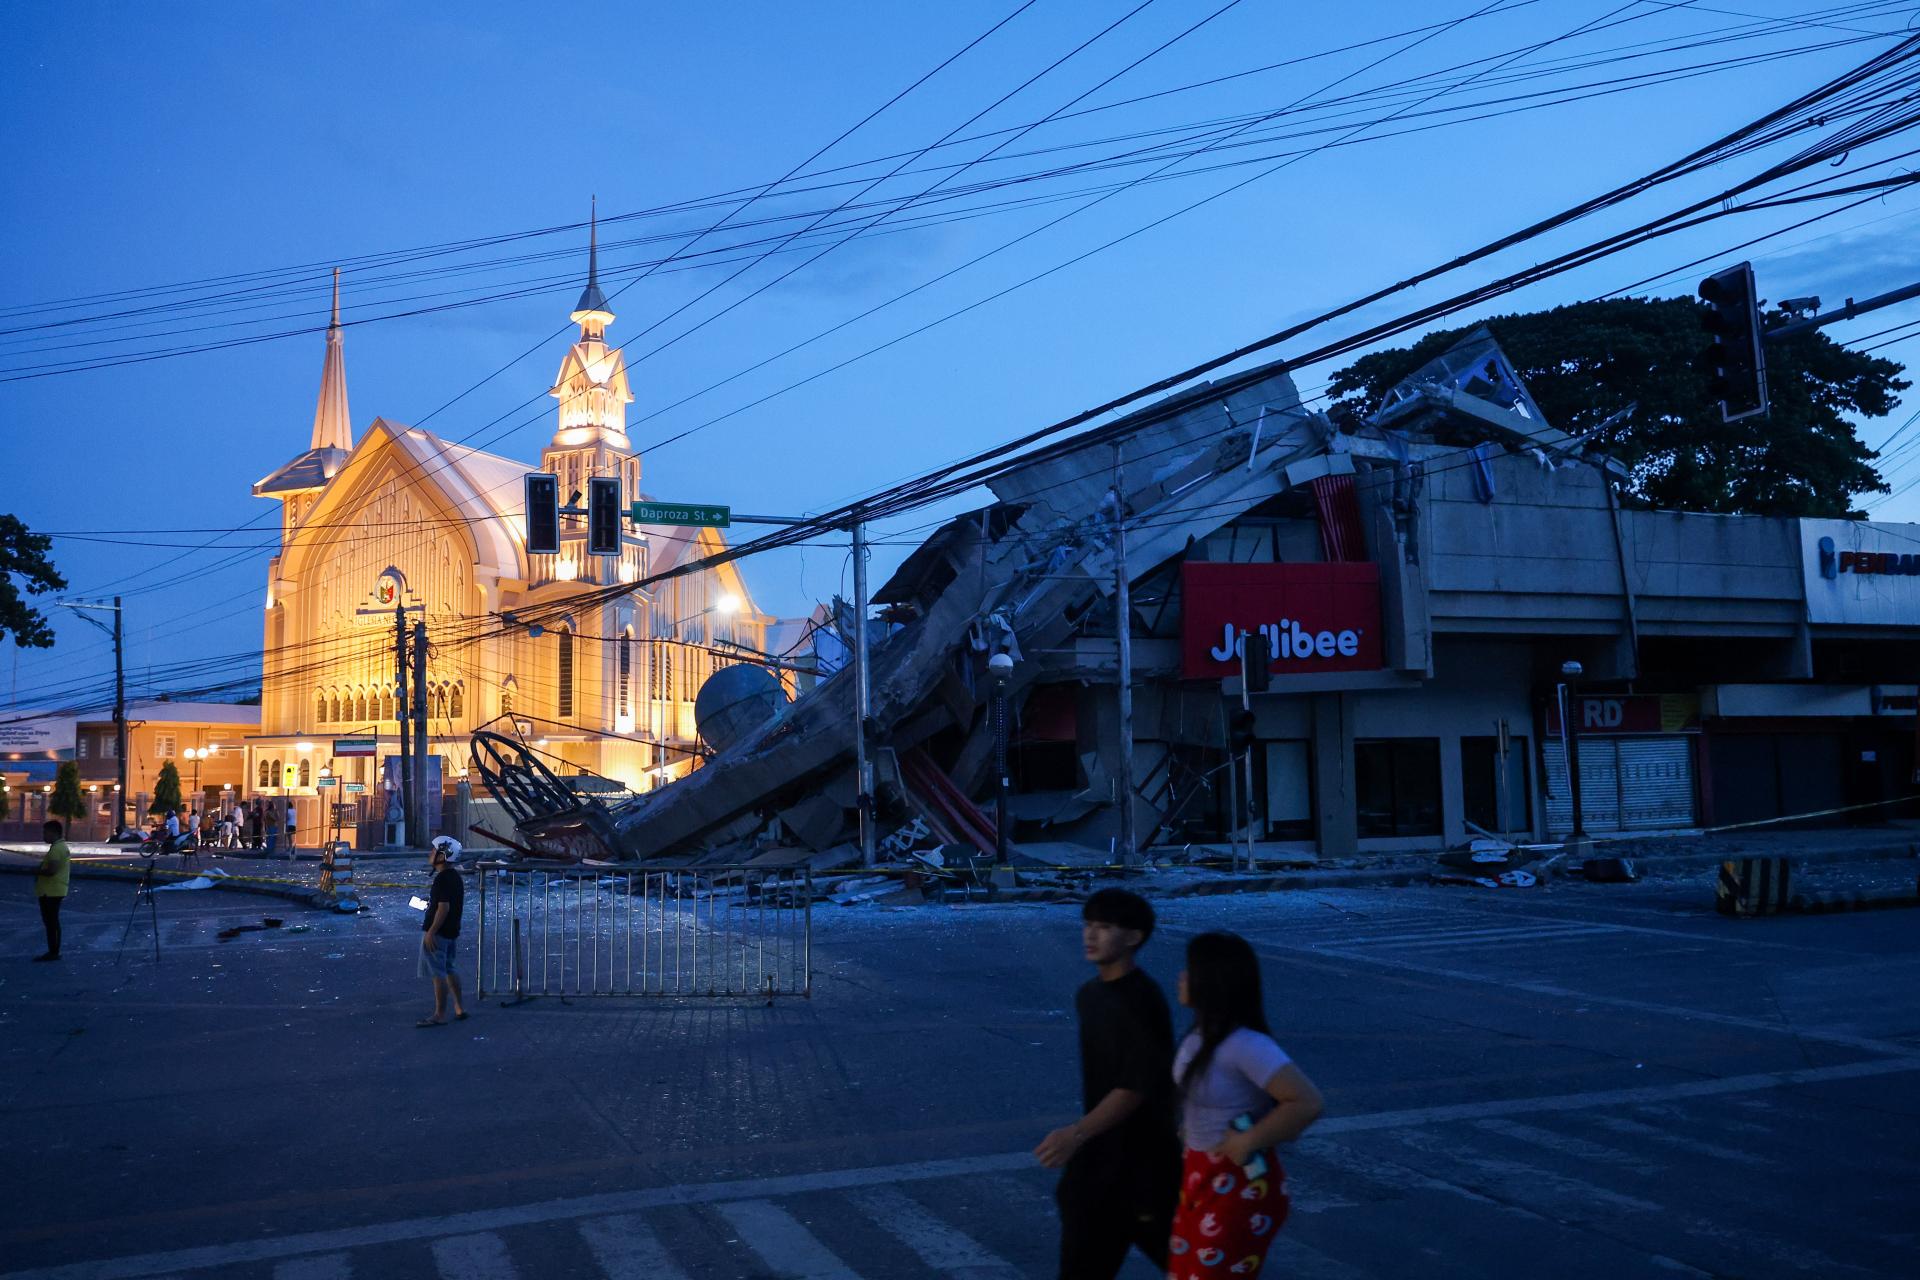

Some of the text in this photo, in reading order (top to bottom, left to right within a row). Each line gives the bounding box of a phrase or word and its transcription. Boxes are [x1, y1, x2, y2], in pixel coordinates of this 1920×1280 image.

[641, 507, 709, 521] Daproza St.
[1210, 618, 1359, 662] Jlibee
[1583, 699, 1624, 728] RD
